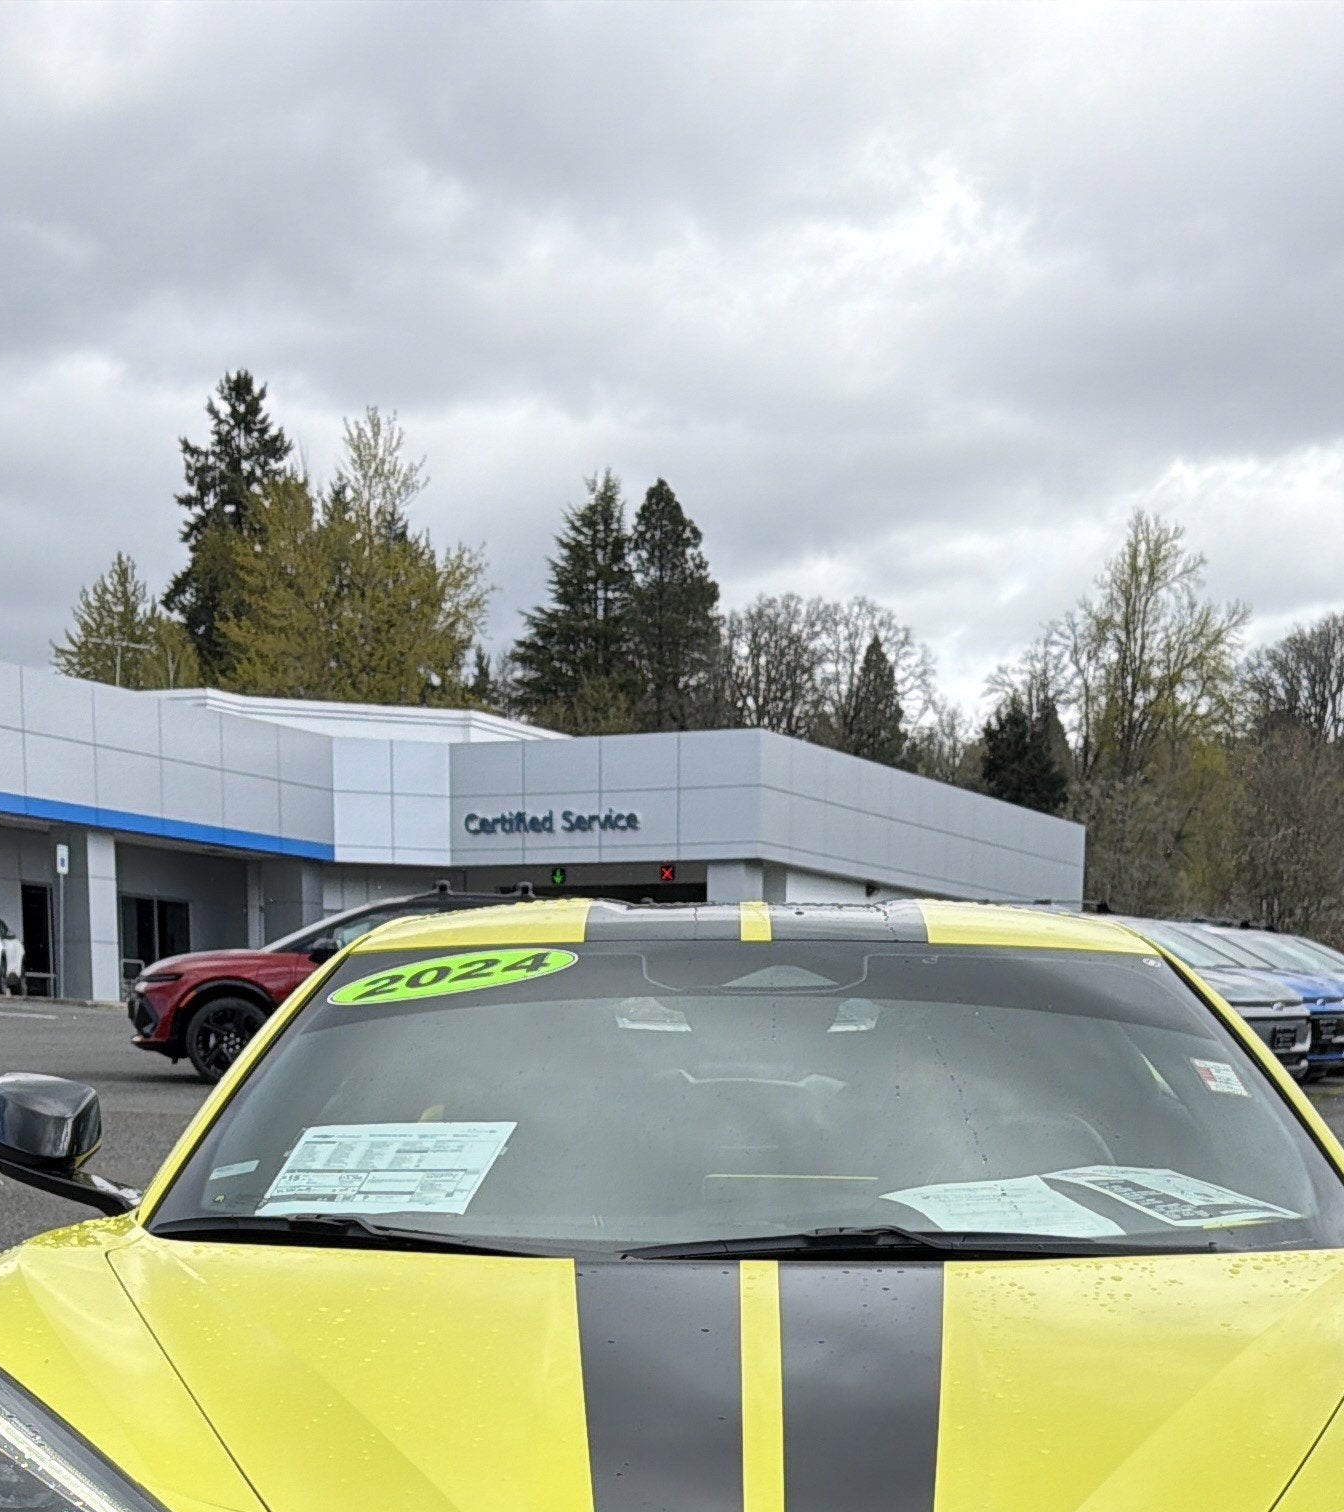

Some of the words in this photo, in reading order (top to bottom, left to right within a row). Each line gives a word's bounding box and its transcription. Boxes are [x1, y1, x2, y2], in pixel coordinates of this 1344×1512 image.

[464, 810, 554, 834] Certified
[561, 808, 640, 832] Service
[352, 951, 552, 1001] 2024
